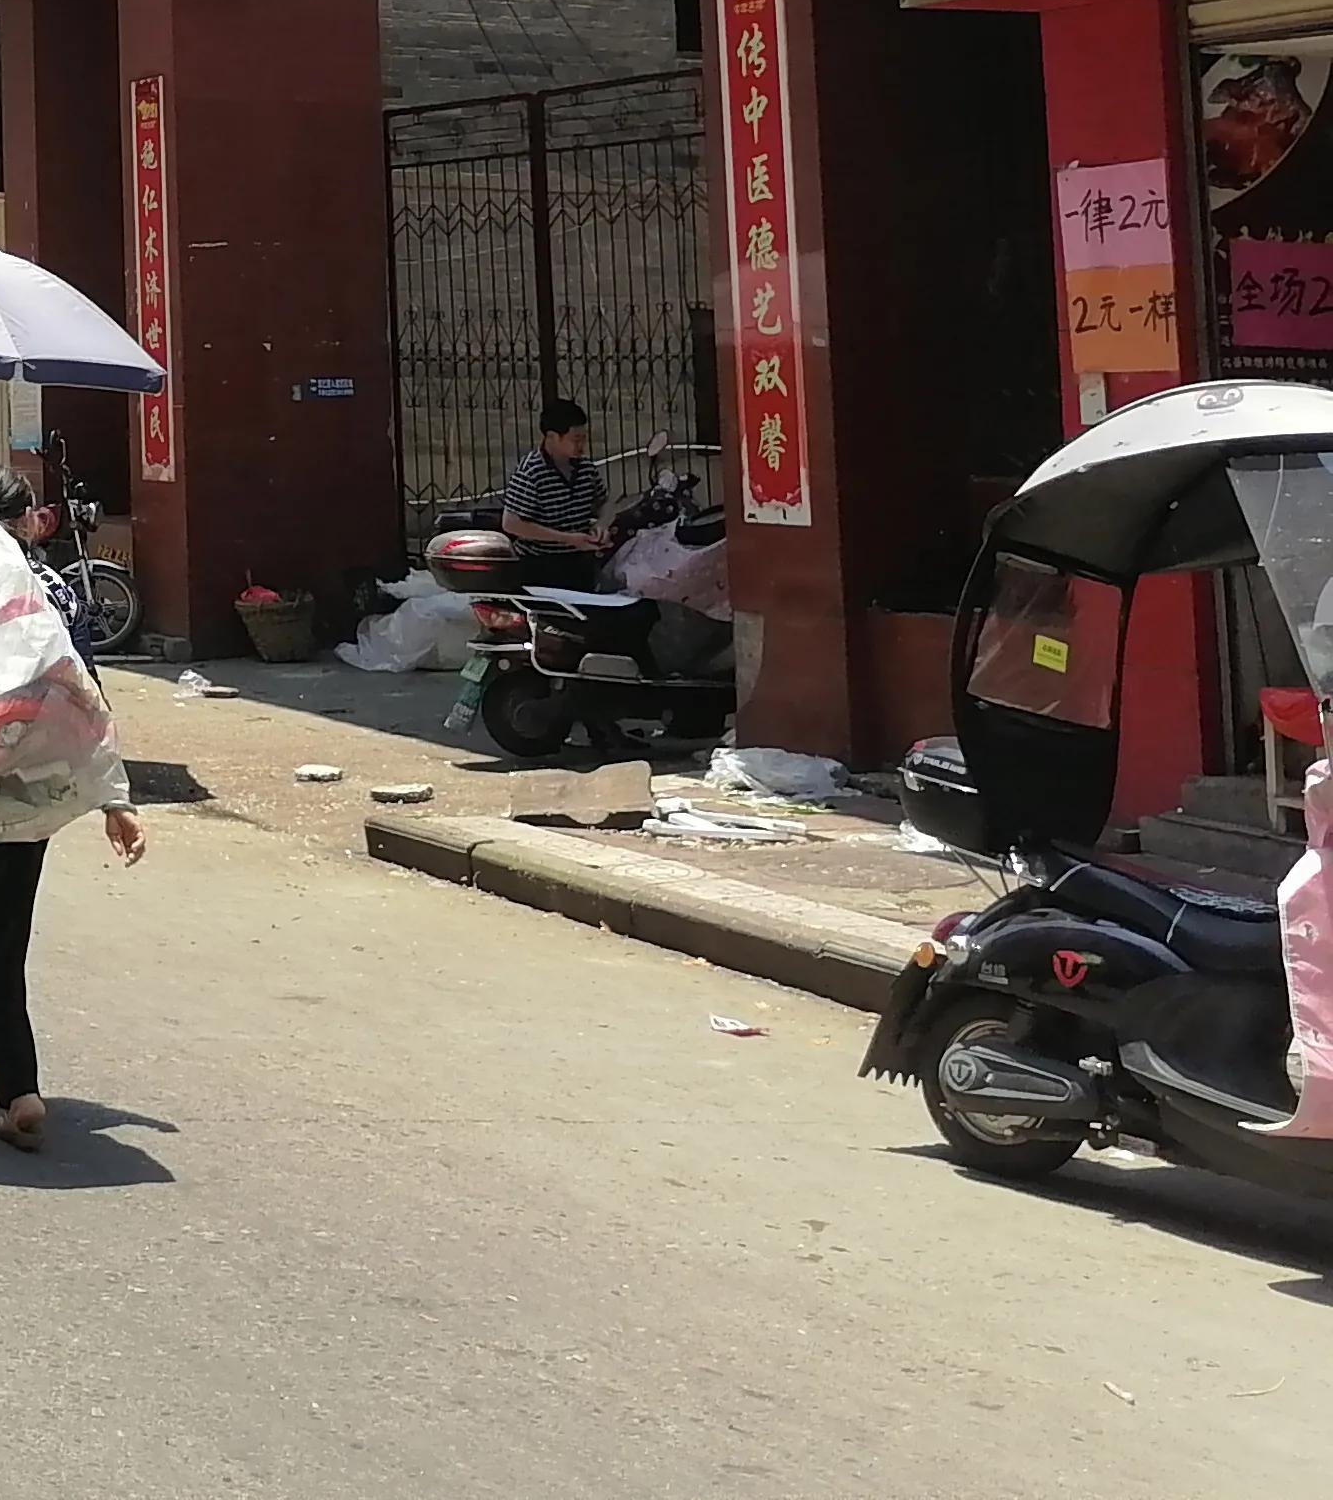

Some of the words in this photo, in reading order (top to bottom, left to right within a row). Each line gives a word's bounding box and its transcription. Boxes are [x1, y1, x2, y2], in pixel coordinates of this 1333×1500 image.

[140, 138, 165, 443] 施仁术济世民
[735, 23, 788, 473] 传中医德艺双馨
[1064, 189, 1170, 243] 一律2元
[1072, 289, 1176, 343] 2元一样
